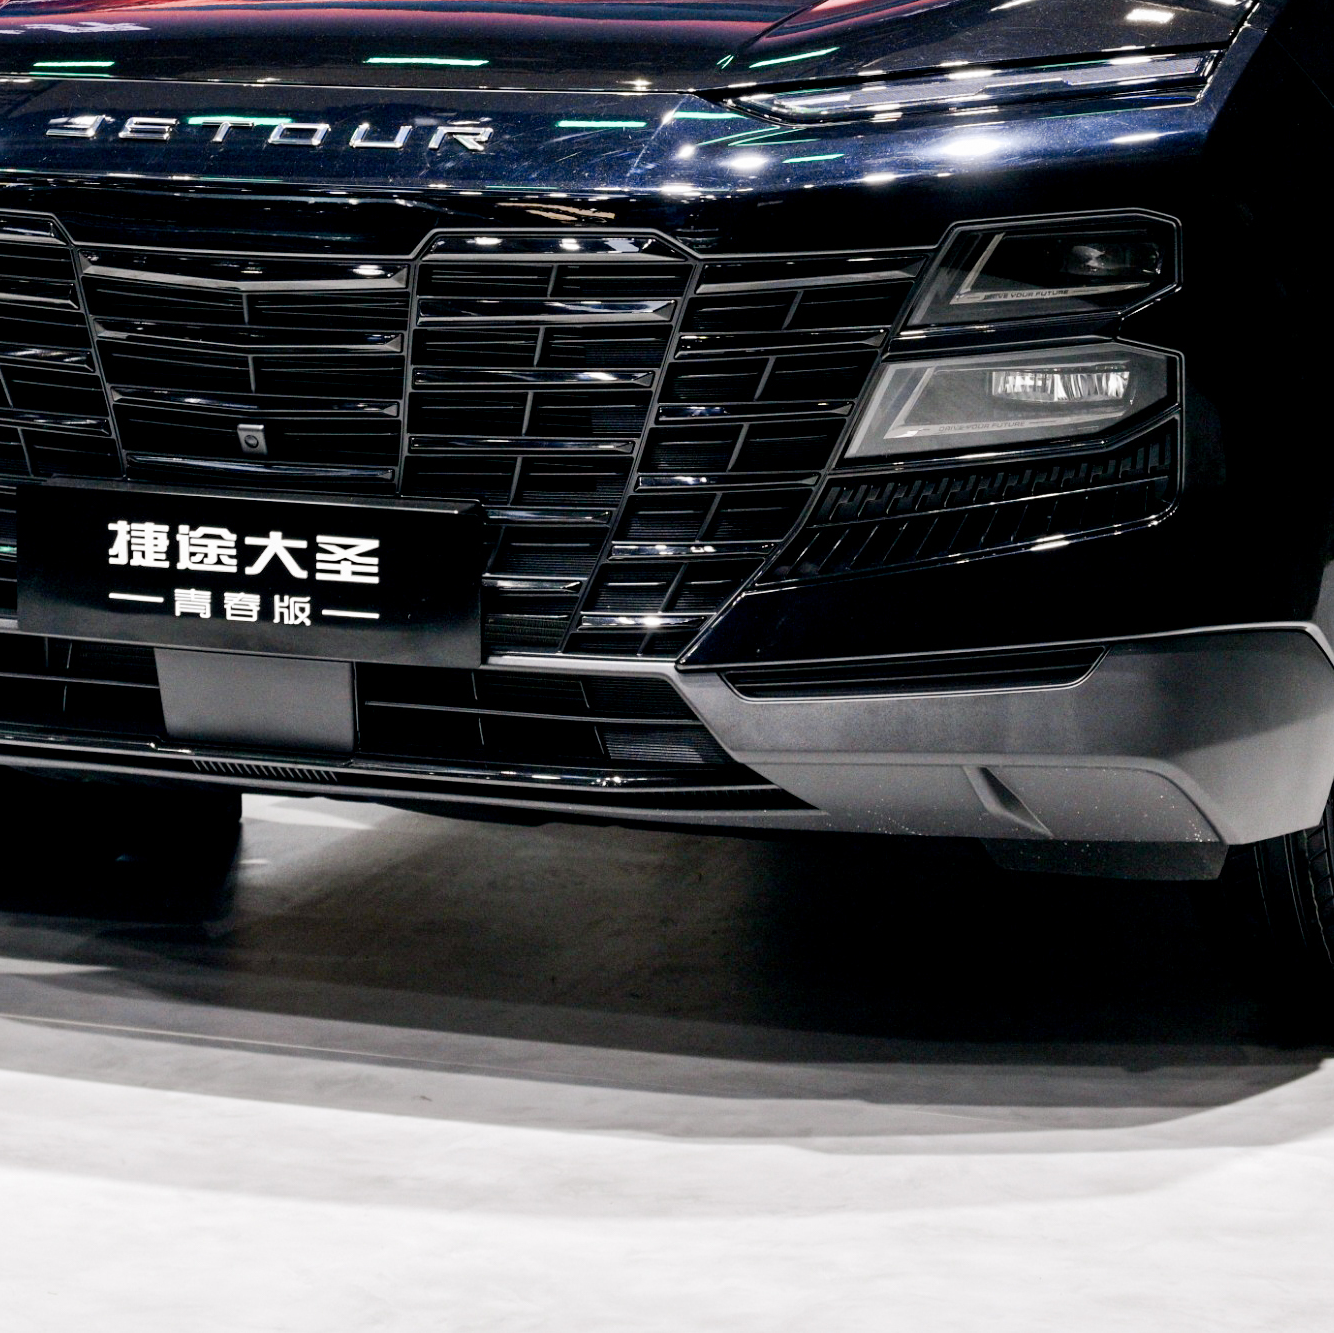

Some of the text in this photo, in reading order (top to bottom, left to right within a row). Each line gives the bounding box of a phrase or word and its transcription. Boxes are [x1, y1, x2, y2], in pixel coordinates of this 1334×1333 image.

[45, 114, 494, 152] JETOUR
[1035, 289, 1070, 298] FUTURE
[991, 420, 1026, 428] FUTURE
[107, 520, 380, 584] 捷途大圣
[174, 588, 311, 627] 青春版
